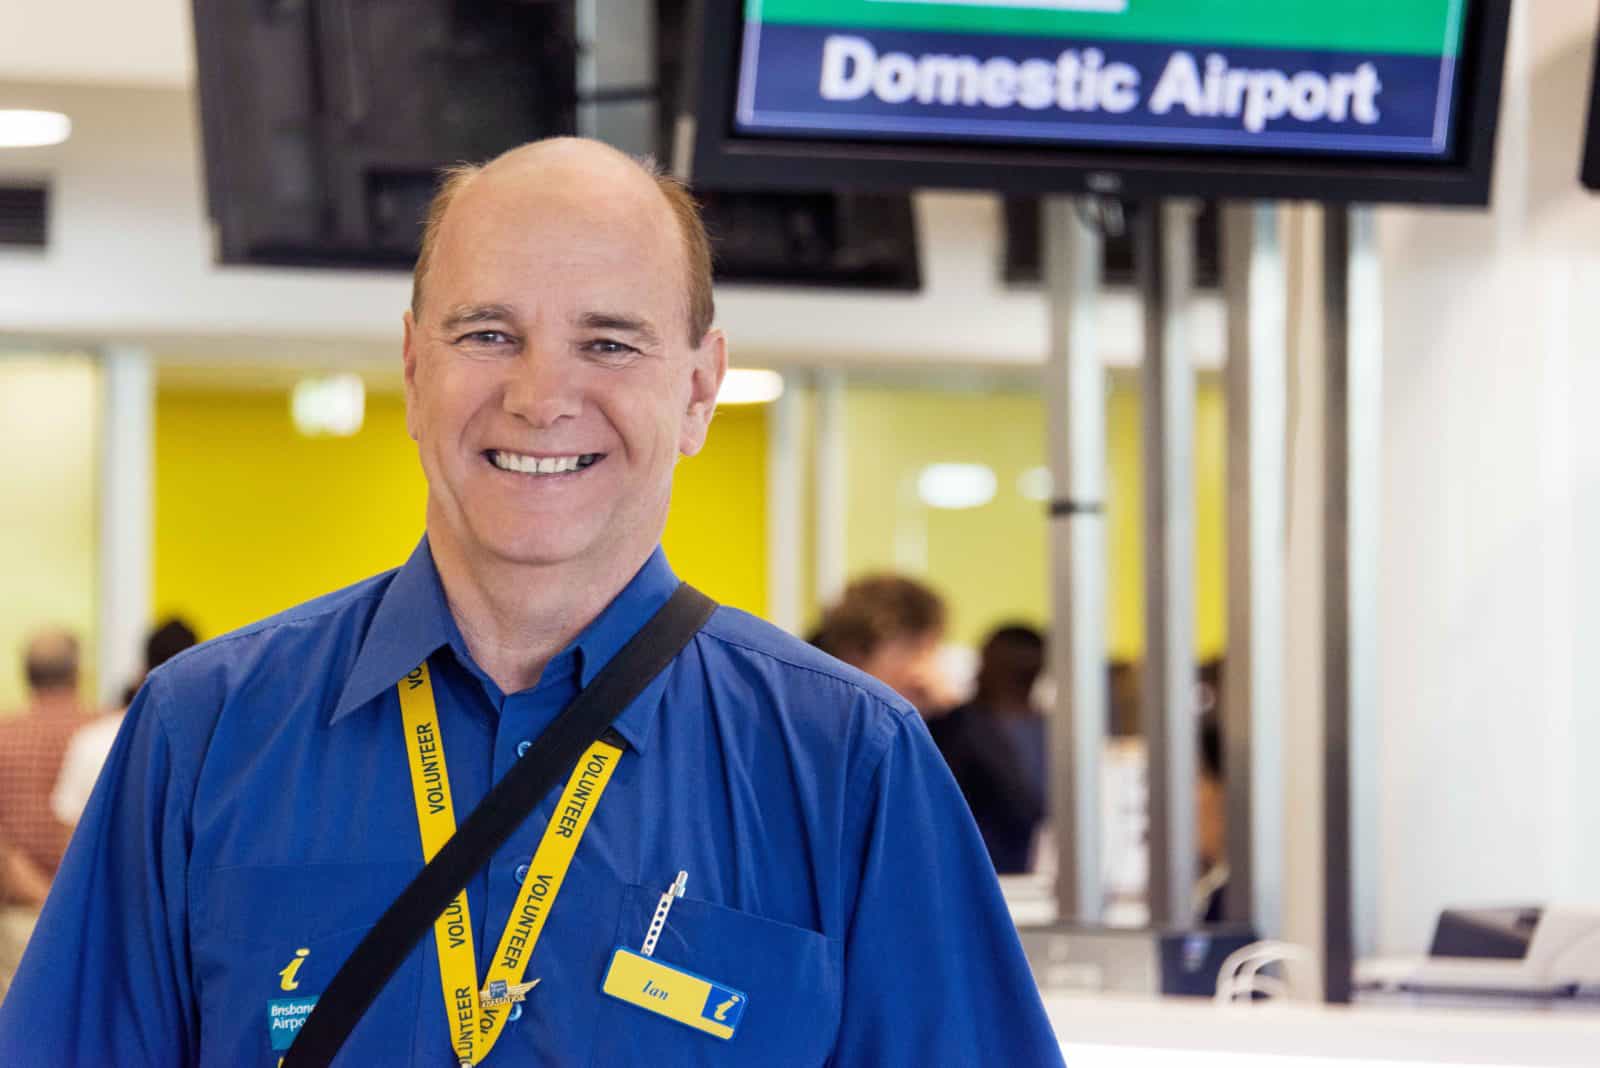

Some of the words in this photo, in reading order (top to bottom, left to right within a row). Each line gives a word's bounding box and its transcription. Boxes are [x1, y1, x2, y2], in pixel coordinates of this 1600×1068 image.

[819, 34, 1140, 113] Domestic
[1149, 51, 1381, 132] Airport
[416, 721, 446, 815] VOLUNTEER
[555, 753, 609, 839] VOLUNTEER
[447, 899, 466, 949] VOLU
[501, 873, 553, 969] VOLUNTEER
[642, 980, 668, 1000] Ian
